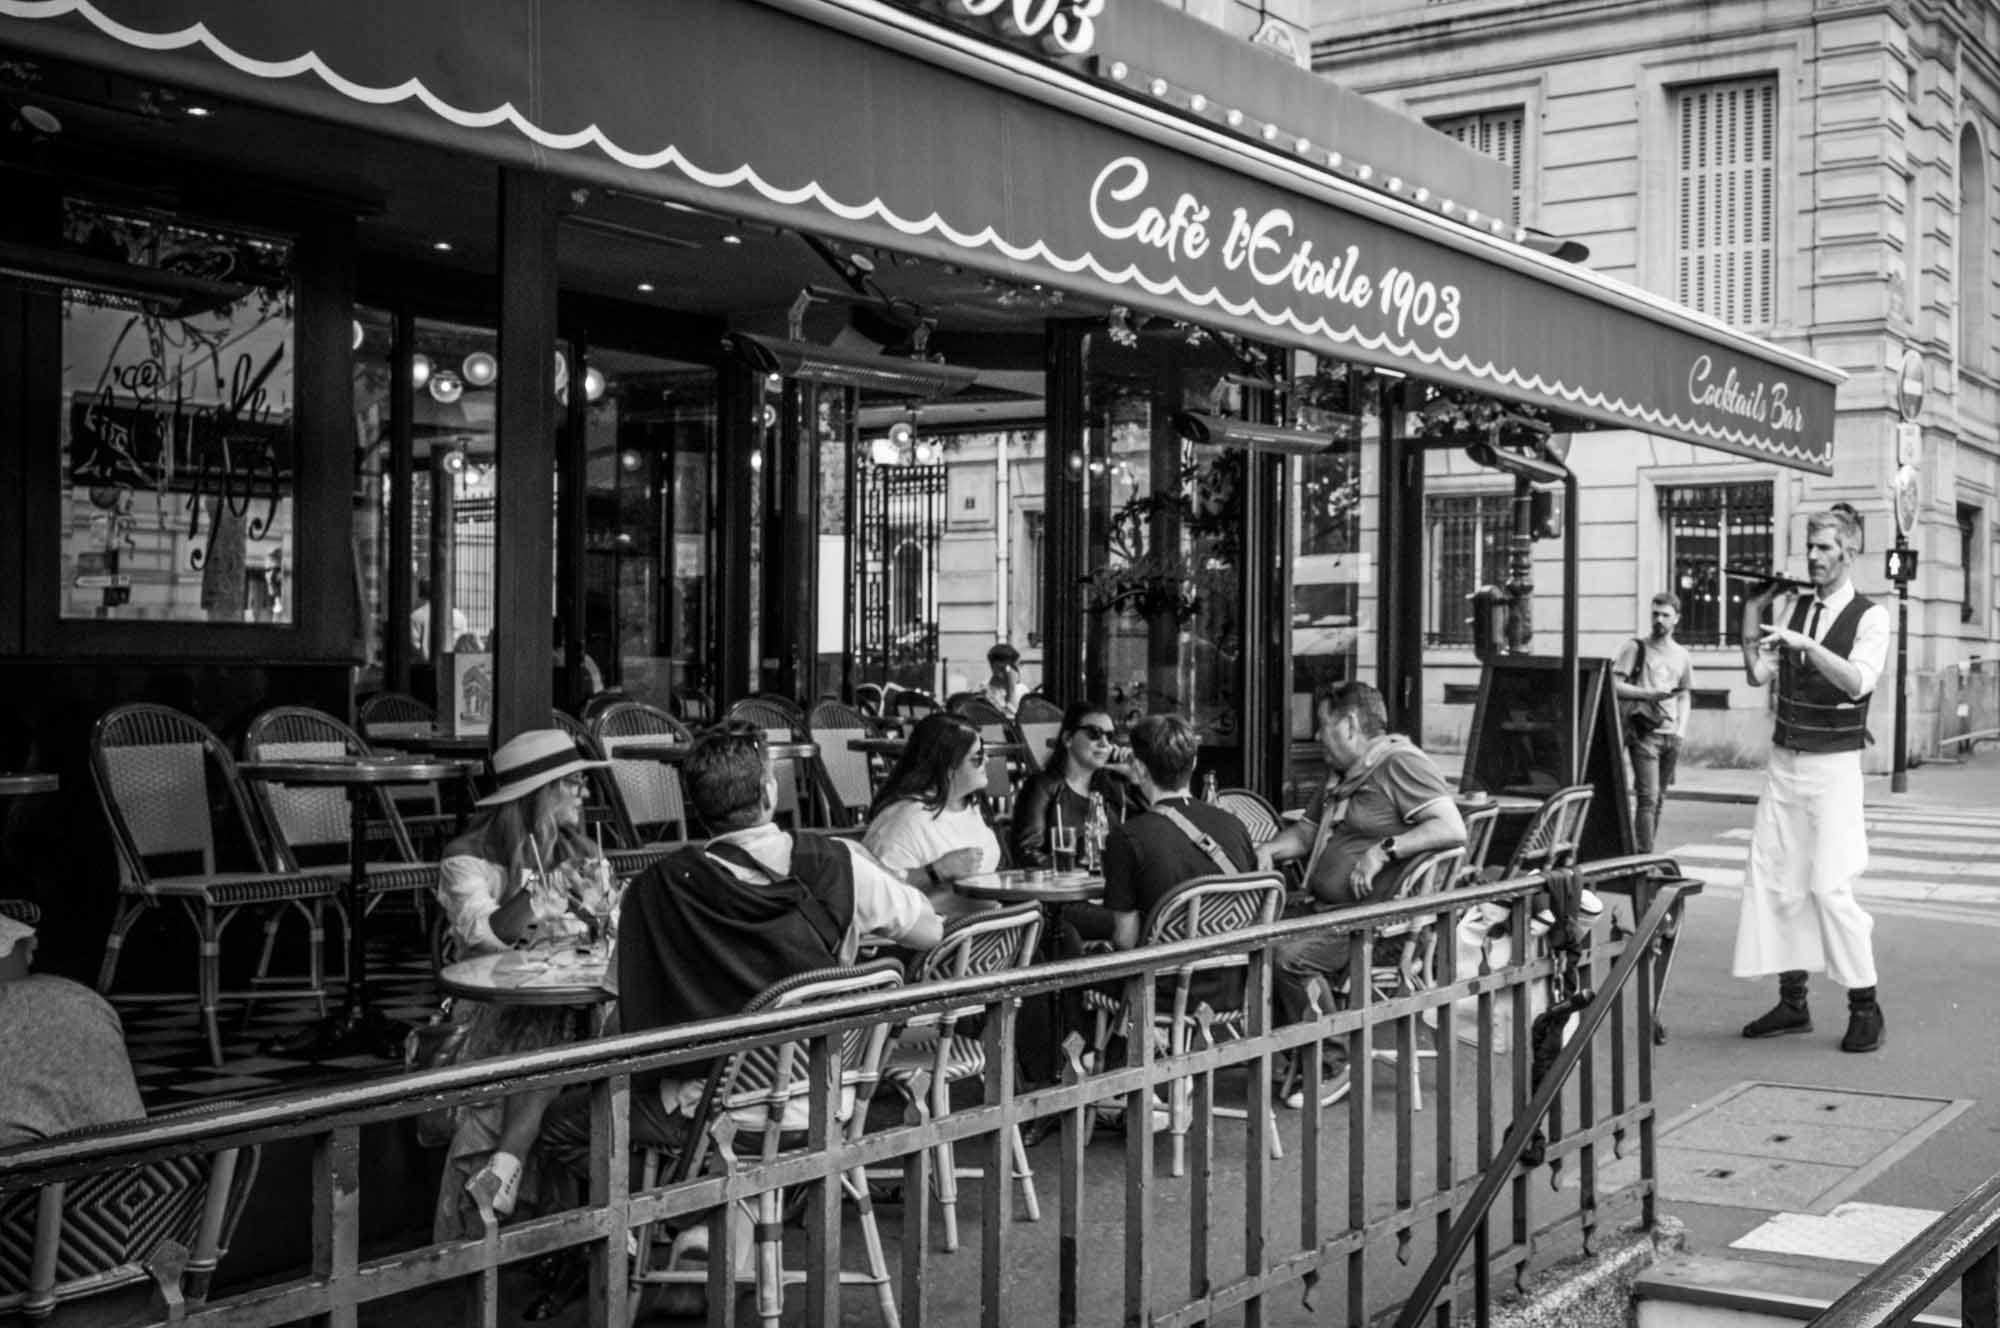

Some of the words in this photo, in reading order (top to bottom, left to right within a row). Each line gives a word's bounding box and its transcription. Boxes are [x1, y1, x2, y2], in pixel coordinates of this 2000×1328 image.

[1089, 156, 1211, 264] Café
[1222, 207, 1374, 309] l'Etoile
[1378, 266, 1462, 340] 1903
[1688, 354, 1767, 423] Cocktails
[1770, 381, 1804, 433] Bar
